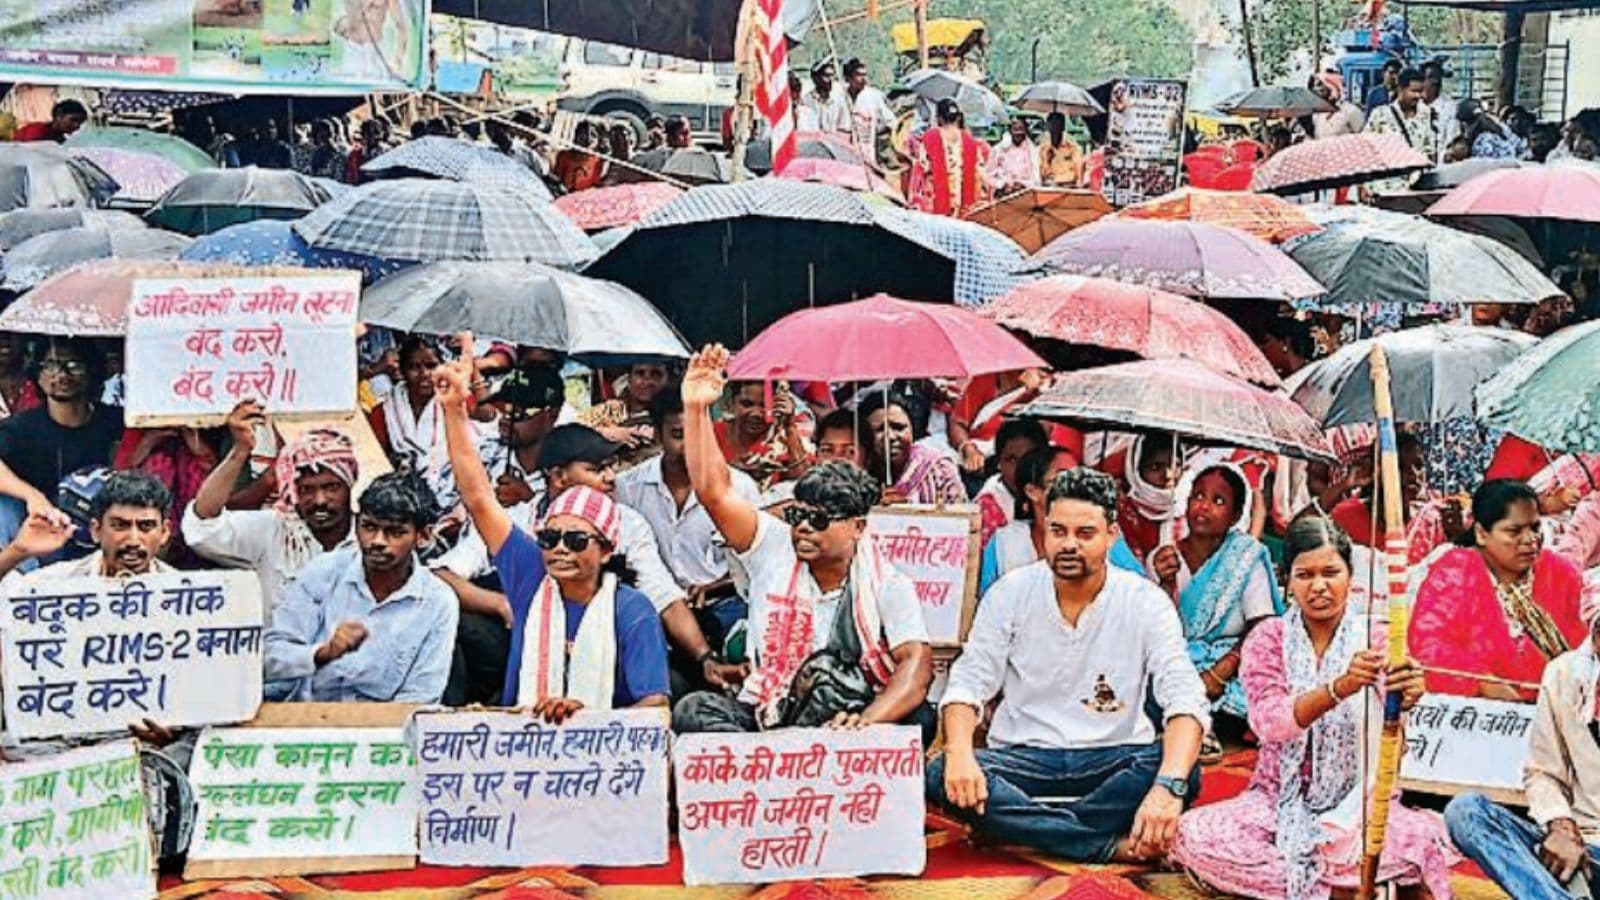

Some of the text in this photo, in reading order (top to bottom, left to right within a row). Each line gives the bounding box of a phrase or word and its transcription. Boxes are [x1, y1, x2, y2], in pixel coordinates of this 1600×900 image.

[134, 285, 355, 323] आदिवासी जमीन लूटना
[185, 324, 224, 359] बंद
[173, 363, 214, 403] बंद
[9, 579, 225, 634] बंदूक की नोक
[15, 625, 263, 670] पर RIMS-2 बनाना
[17, 676, 78, 719] बंद
[420, 722, 490, 762] हमारी
[562, 720, 625, 760] हमारी
[1450, 705, 1479, 732] की
[1479, 708, 1534, 738] जमीन
[273, 741, 358, 775] कानून
[682, 745, 738, 786] कांके
[739, 745, 776, 785] की
[776, 741, 828, 782] माटी
[314, 780, 406, 808] करना
[473, 770, 507, 804] पर
[513, 770, 540, 800] न
[543, 761, 604, 801] चलने
[608, 760, 646, 798] देंगे
[682, 791, 761, 831] अपनी
[763, 786, 836, 826] जमीन
